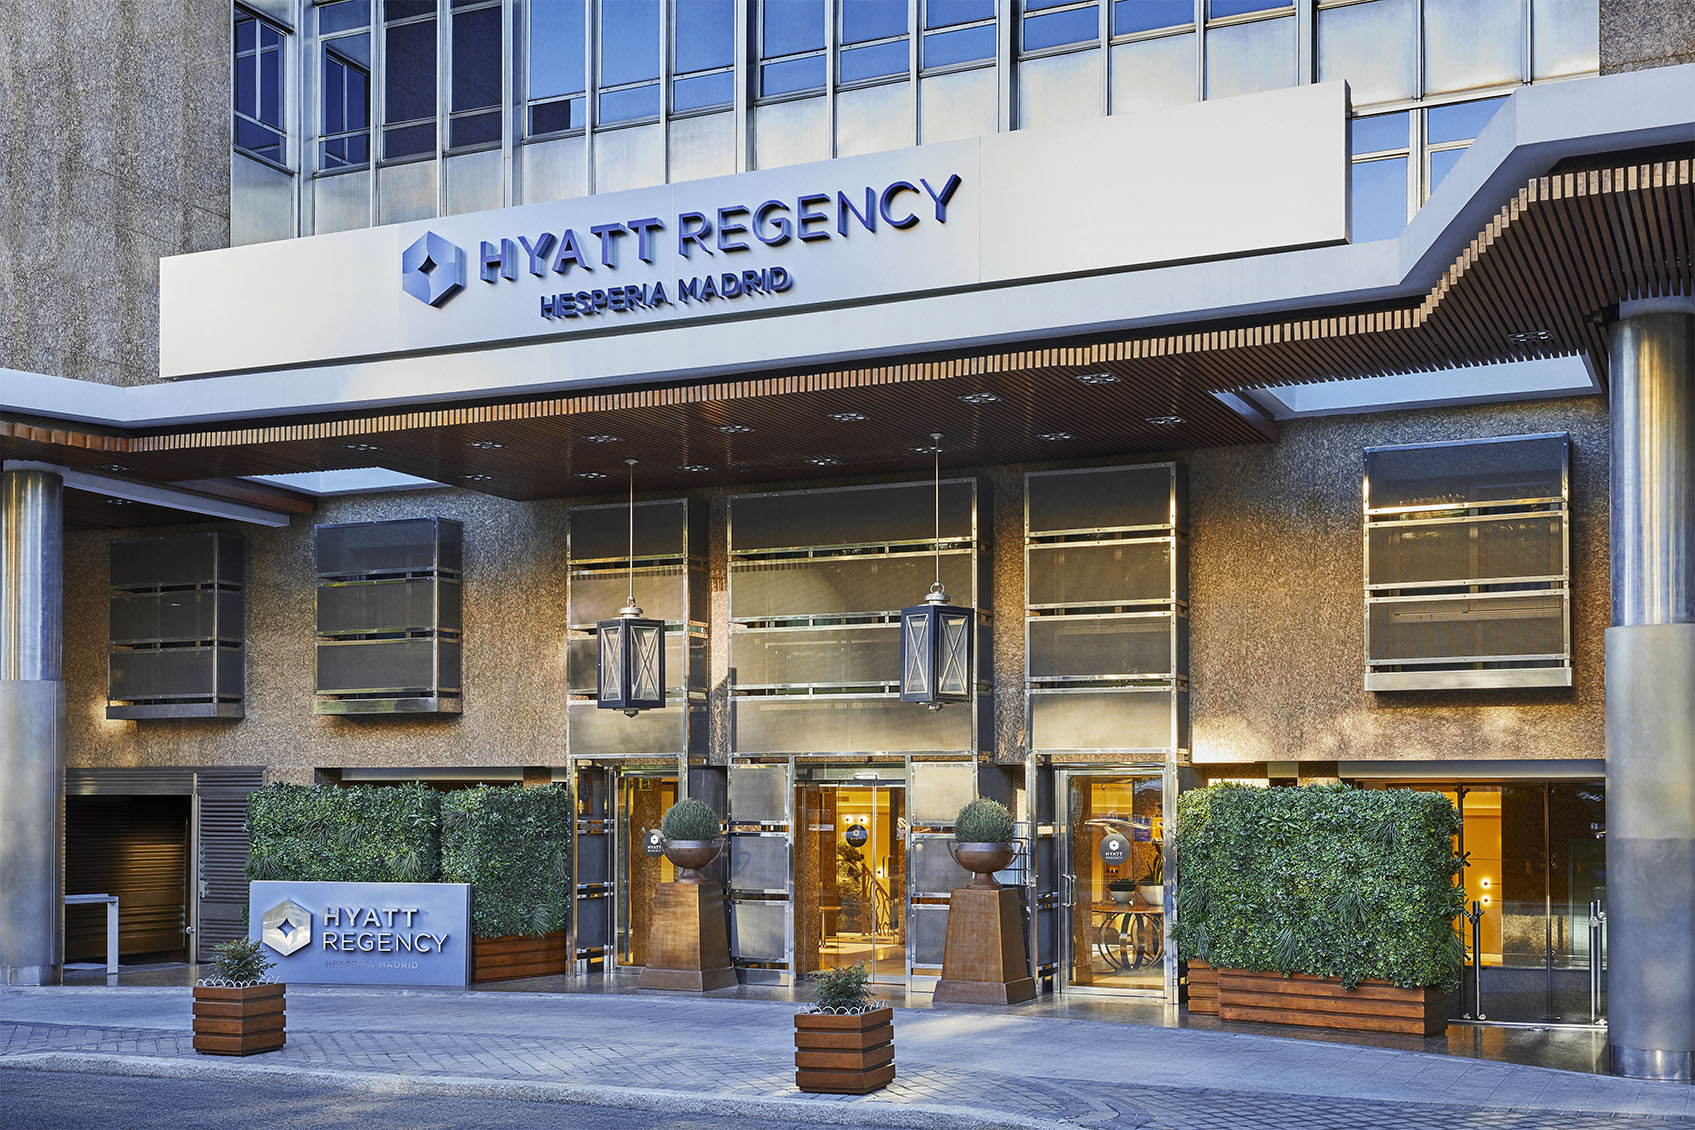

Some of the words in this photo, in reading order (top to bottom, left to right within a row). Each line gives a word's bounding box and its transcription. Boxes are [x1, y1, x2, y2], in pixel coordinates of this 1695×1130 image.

[479, 217, 665, 285] HYATT
[678, 173, 962, 258] REGENCY
[540, 281, 673, 320] HESPERIA
[678, 266, 794, 302] MADRID
[323, 906, 419, 928] HYATT
[322, 931, 449, 953] REGENCY
[325, 960, 375, 969] HESPERIA
[378, 960, 419, 969] MADRID
